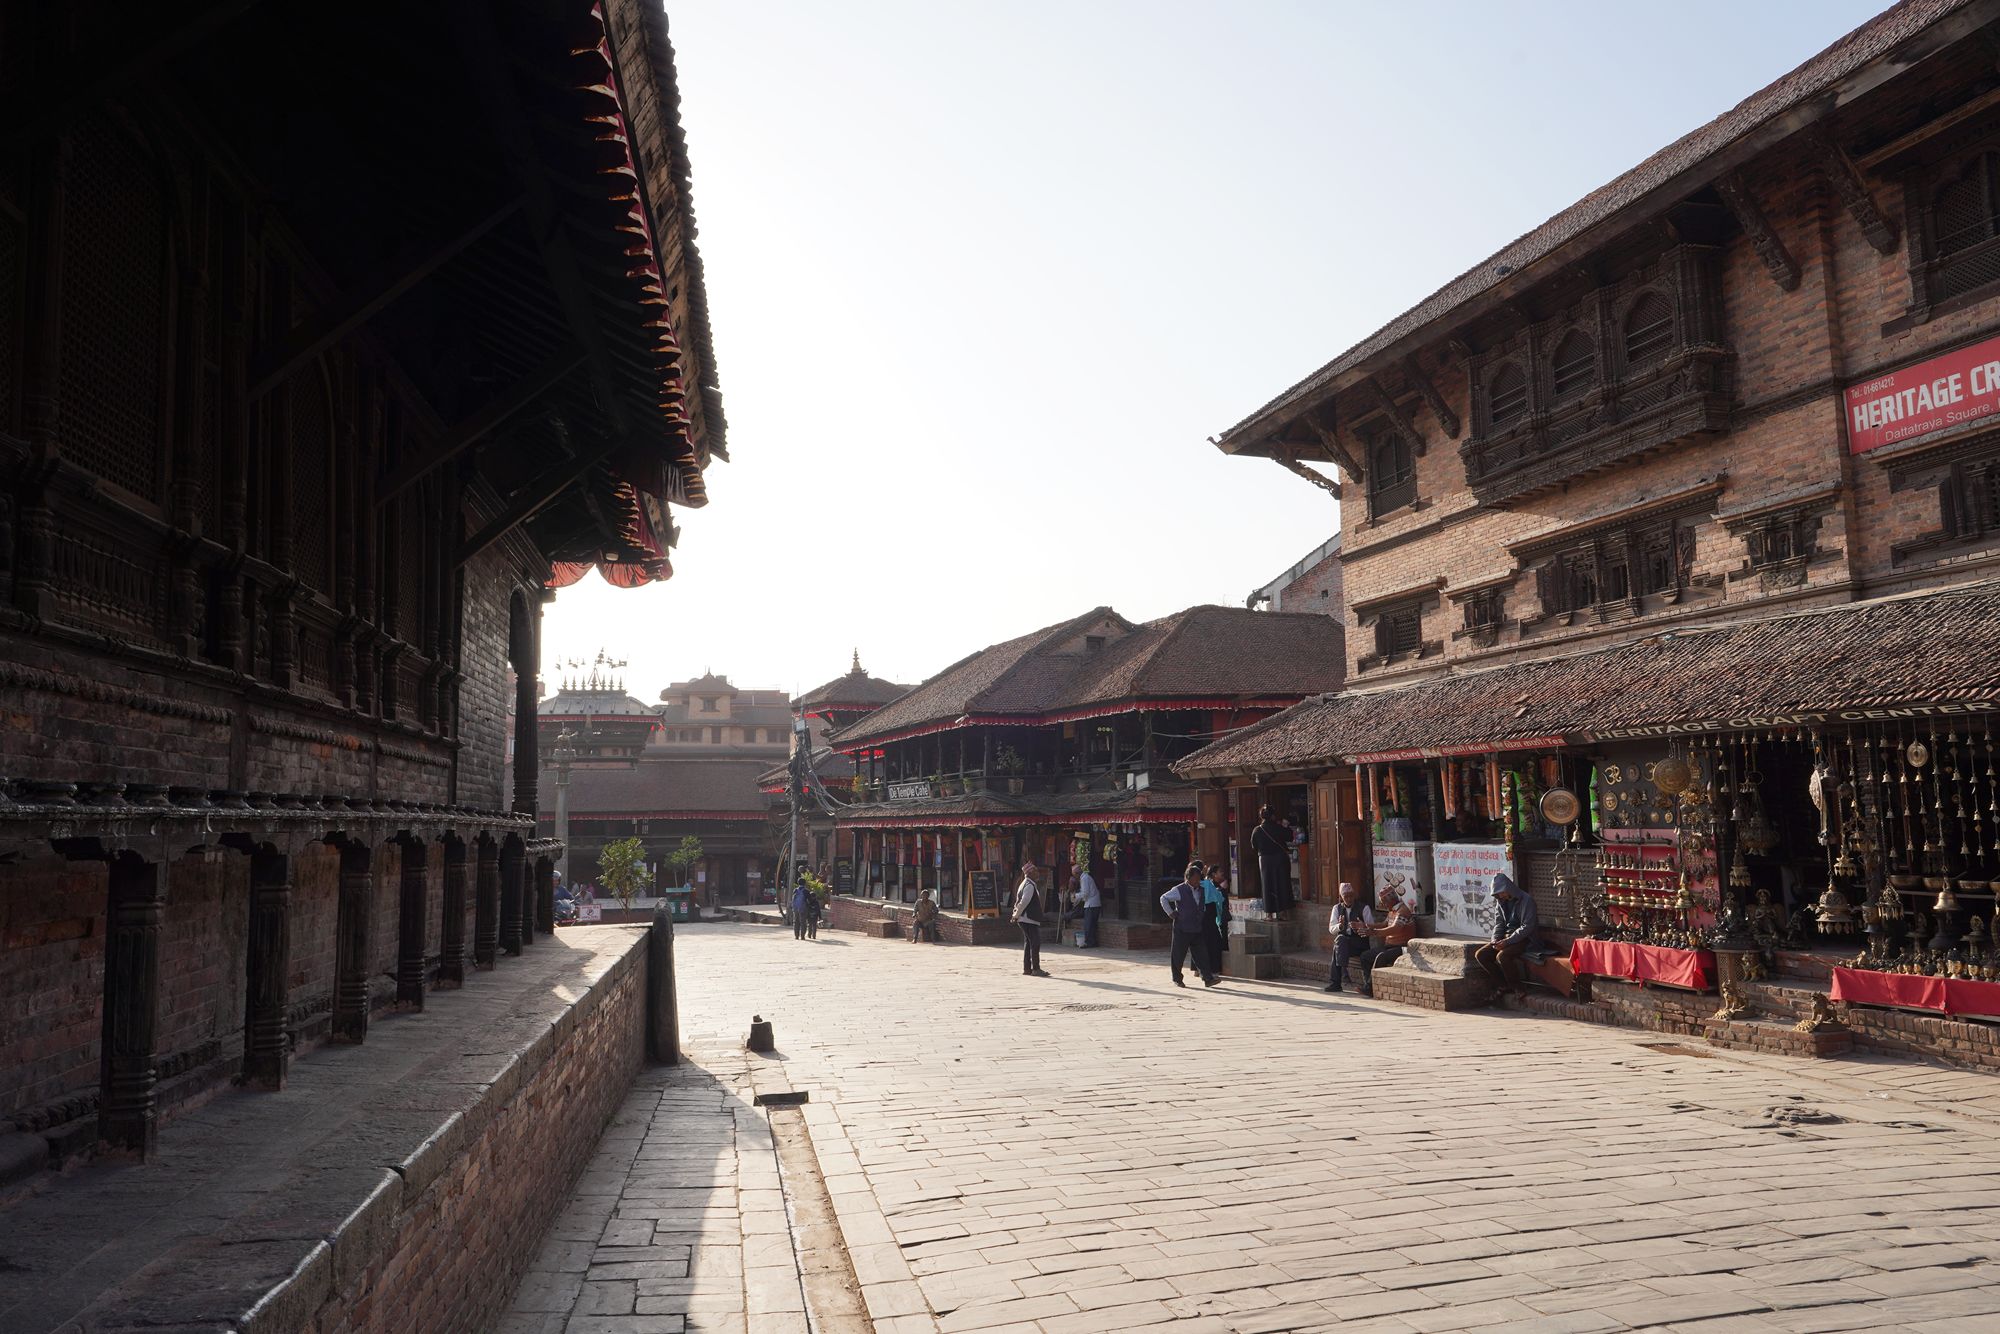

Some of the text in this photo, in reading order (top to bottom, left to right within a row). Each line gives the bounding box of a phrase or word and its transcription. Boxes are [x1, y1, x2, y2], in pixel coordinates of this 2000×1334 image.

[1853, 372, 1964, 433] HERITAGE
[1885, 418, 1943, 441] Dattatraya
[1594, 702, 2000, 740] HERITAGE CRAFT CENTER
[1400, 750, 1421, 758] Curd
[897, 786, 915, 799] Temple
[1465, 866, 1482, 877] King
